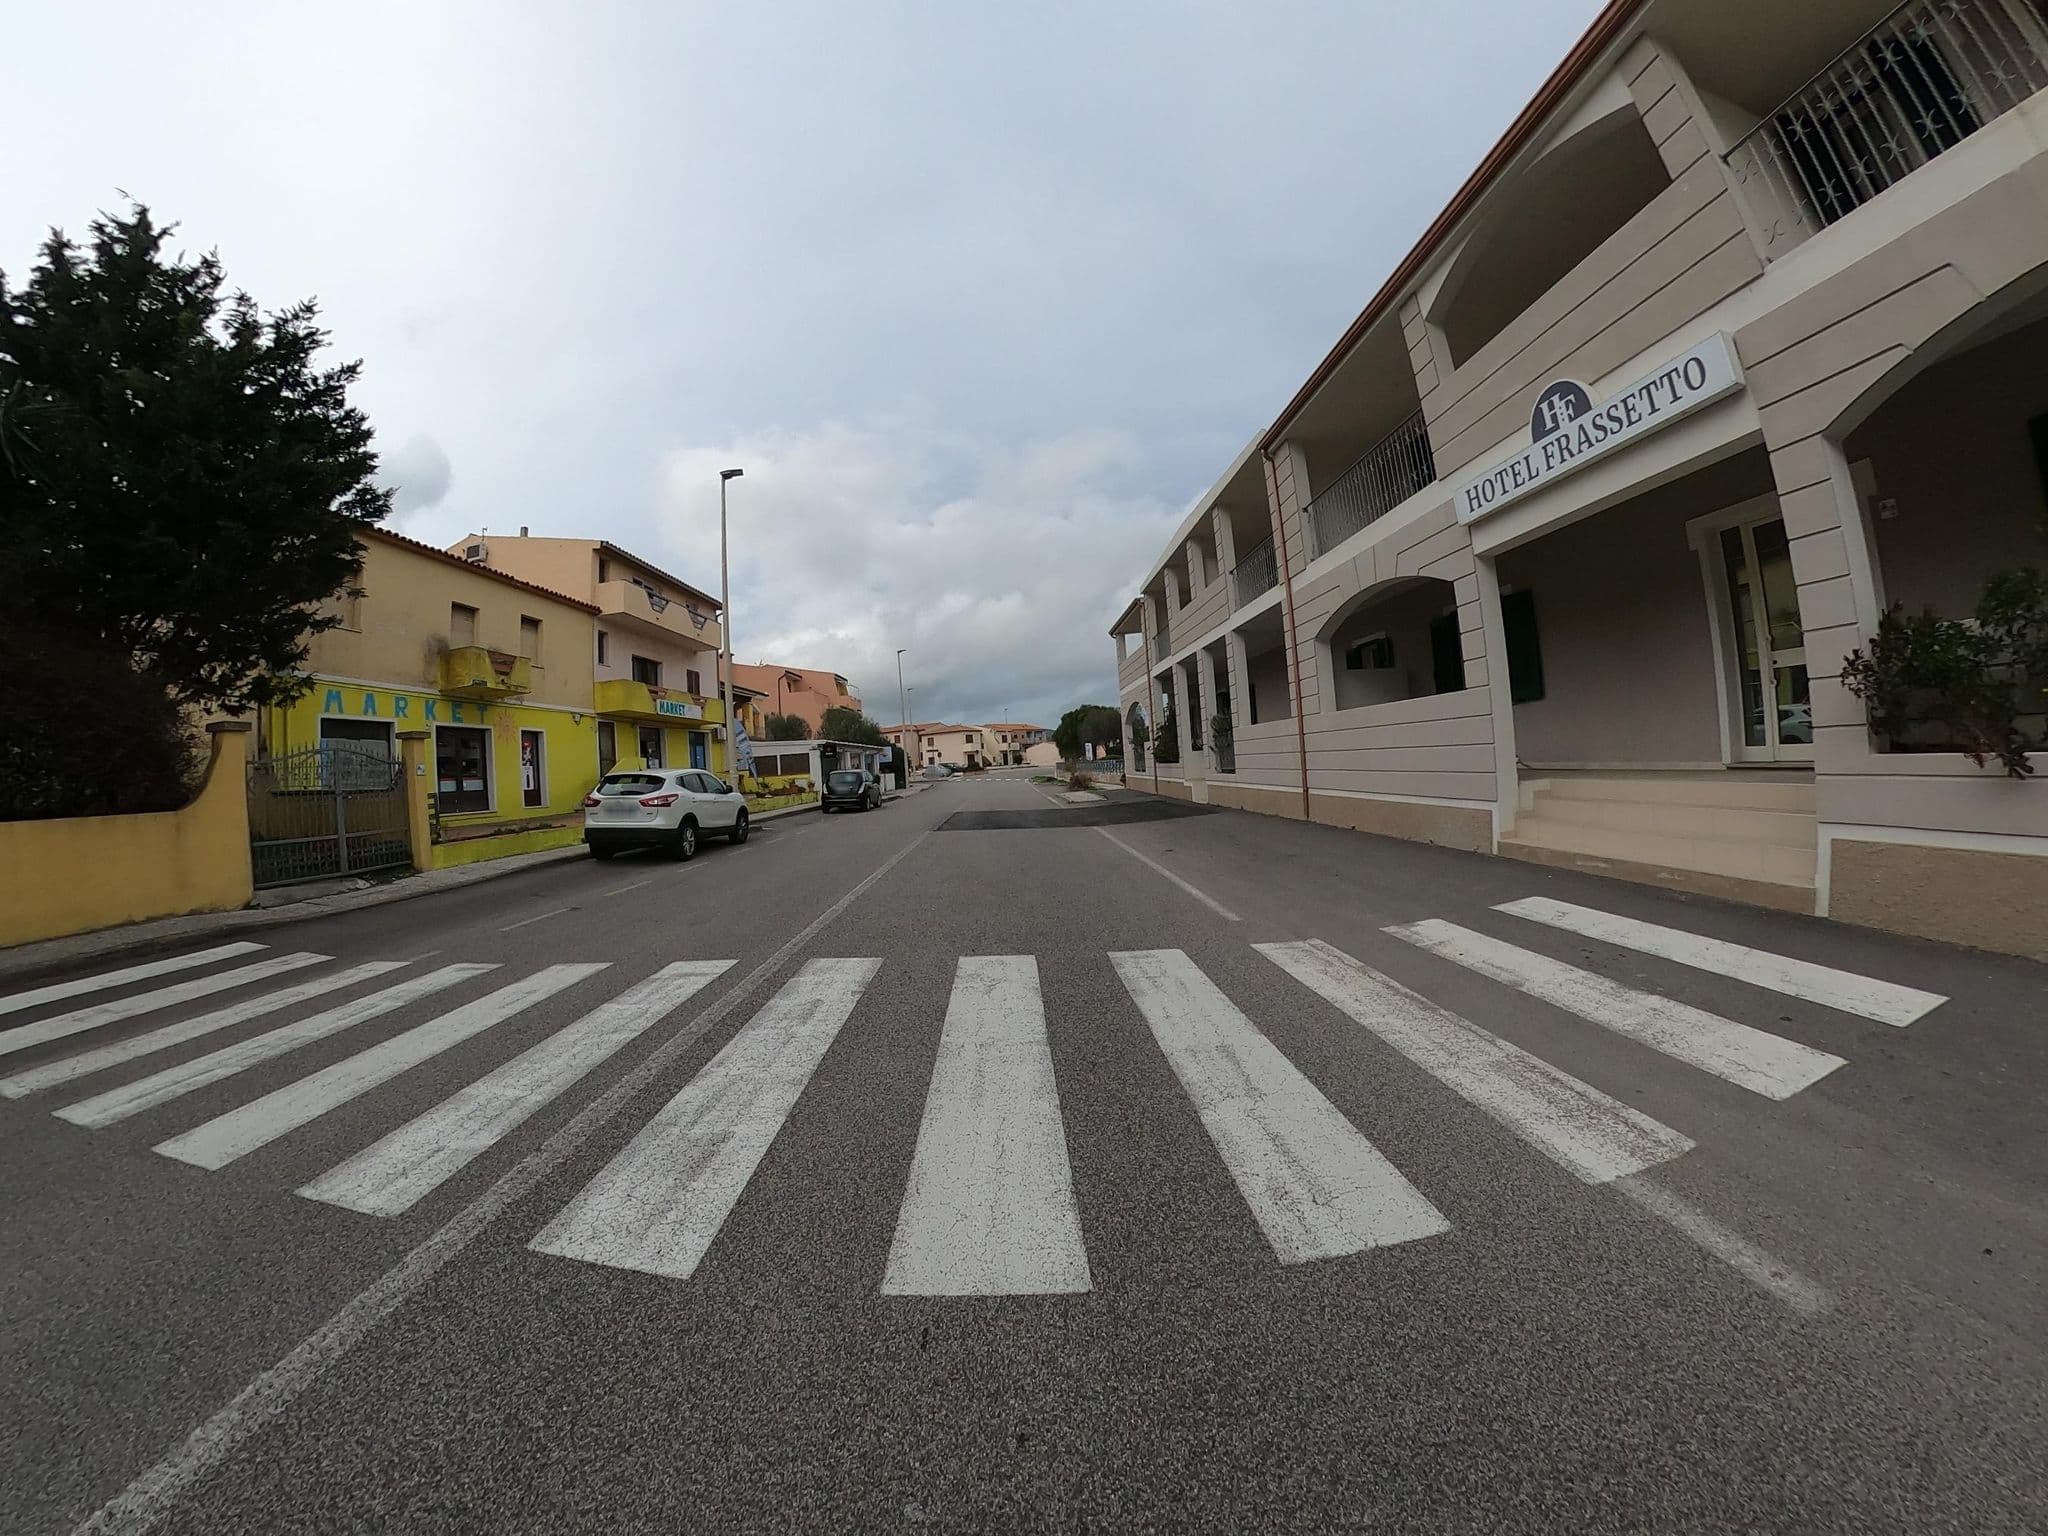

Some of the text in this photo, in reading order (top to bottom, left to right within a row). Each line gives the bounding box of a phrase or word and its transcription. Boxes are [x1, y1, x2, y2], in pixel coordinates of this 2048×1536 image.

[1465, 357, 1707, 513] HOTEL FRASSETTO
[324, 689, 489, 725] MARKET
[659, 700, 686, 716] MARKET
